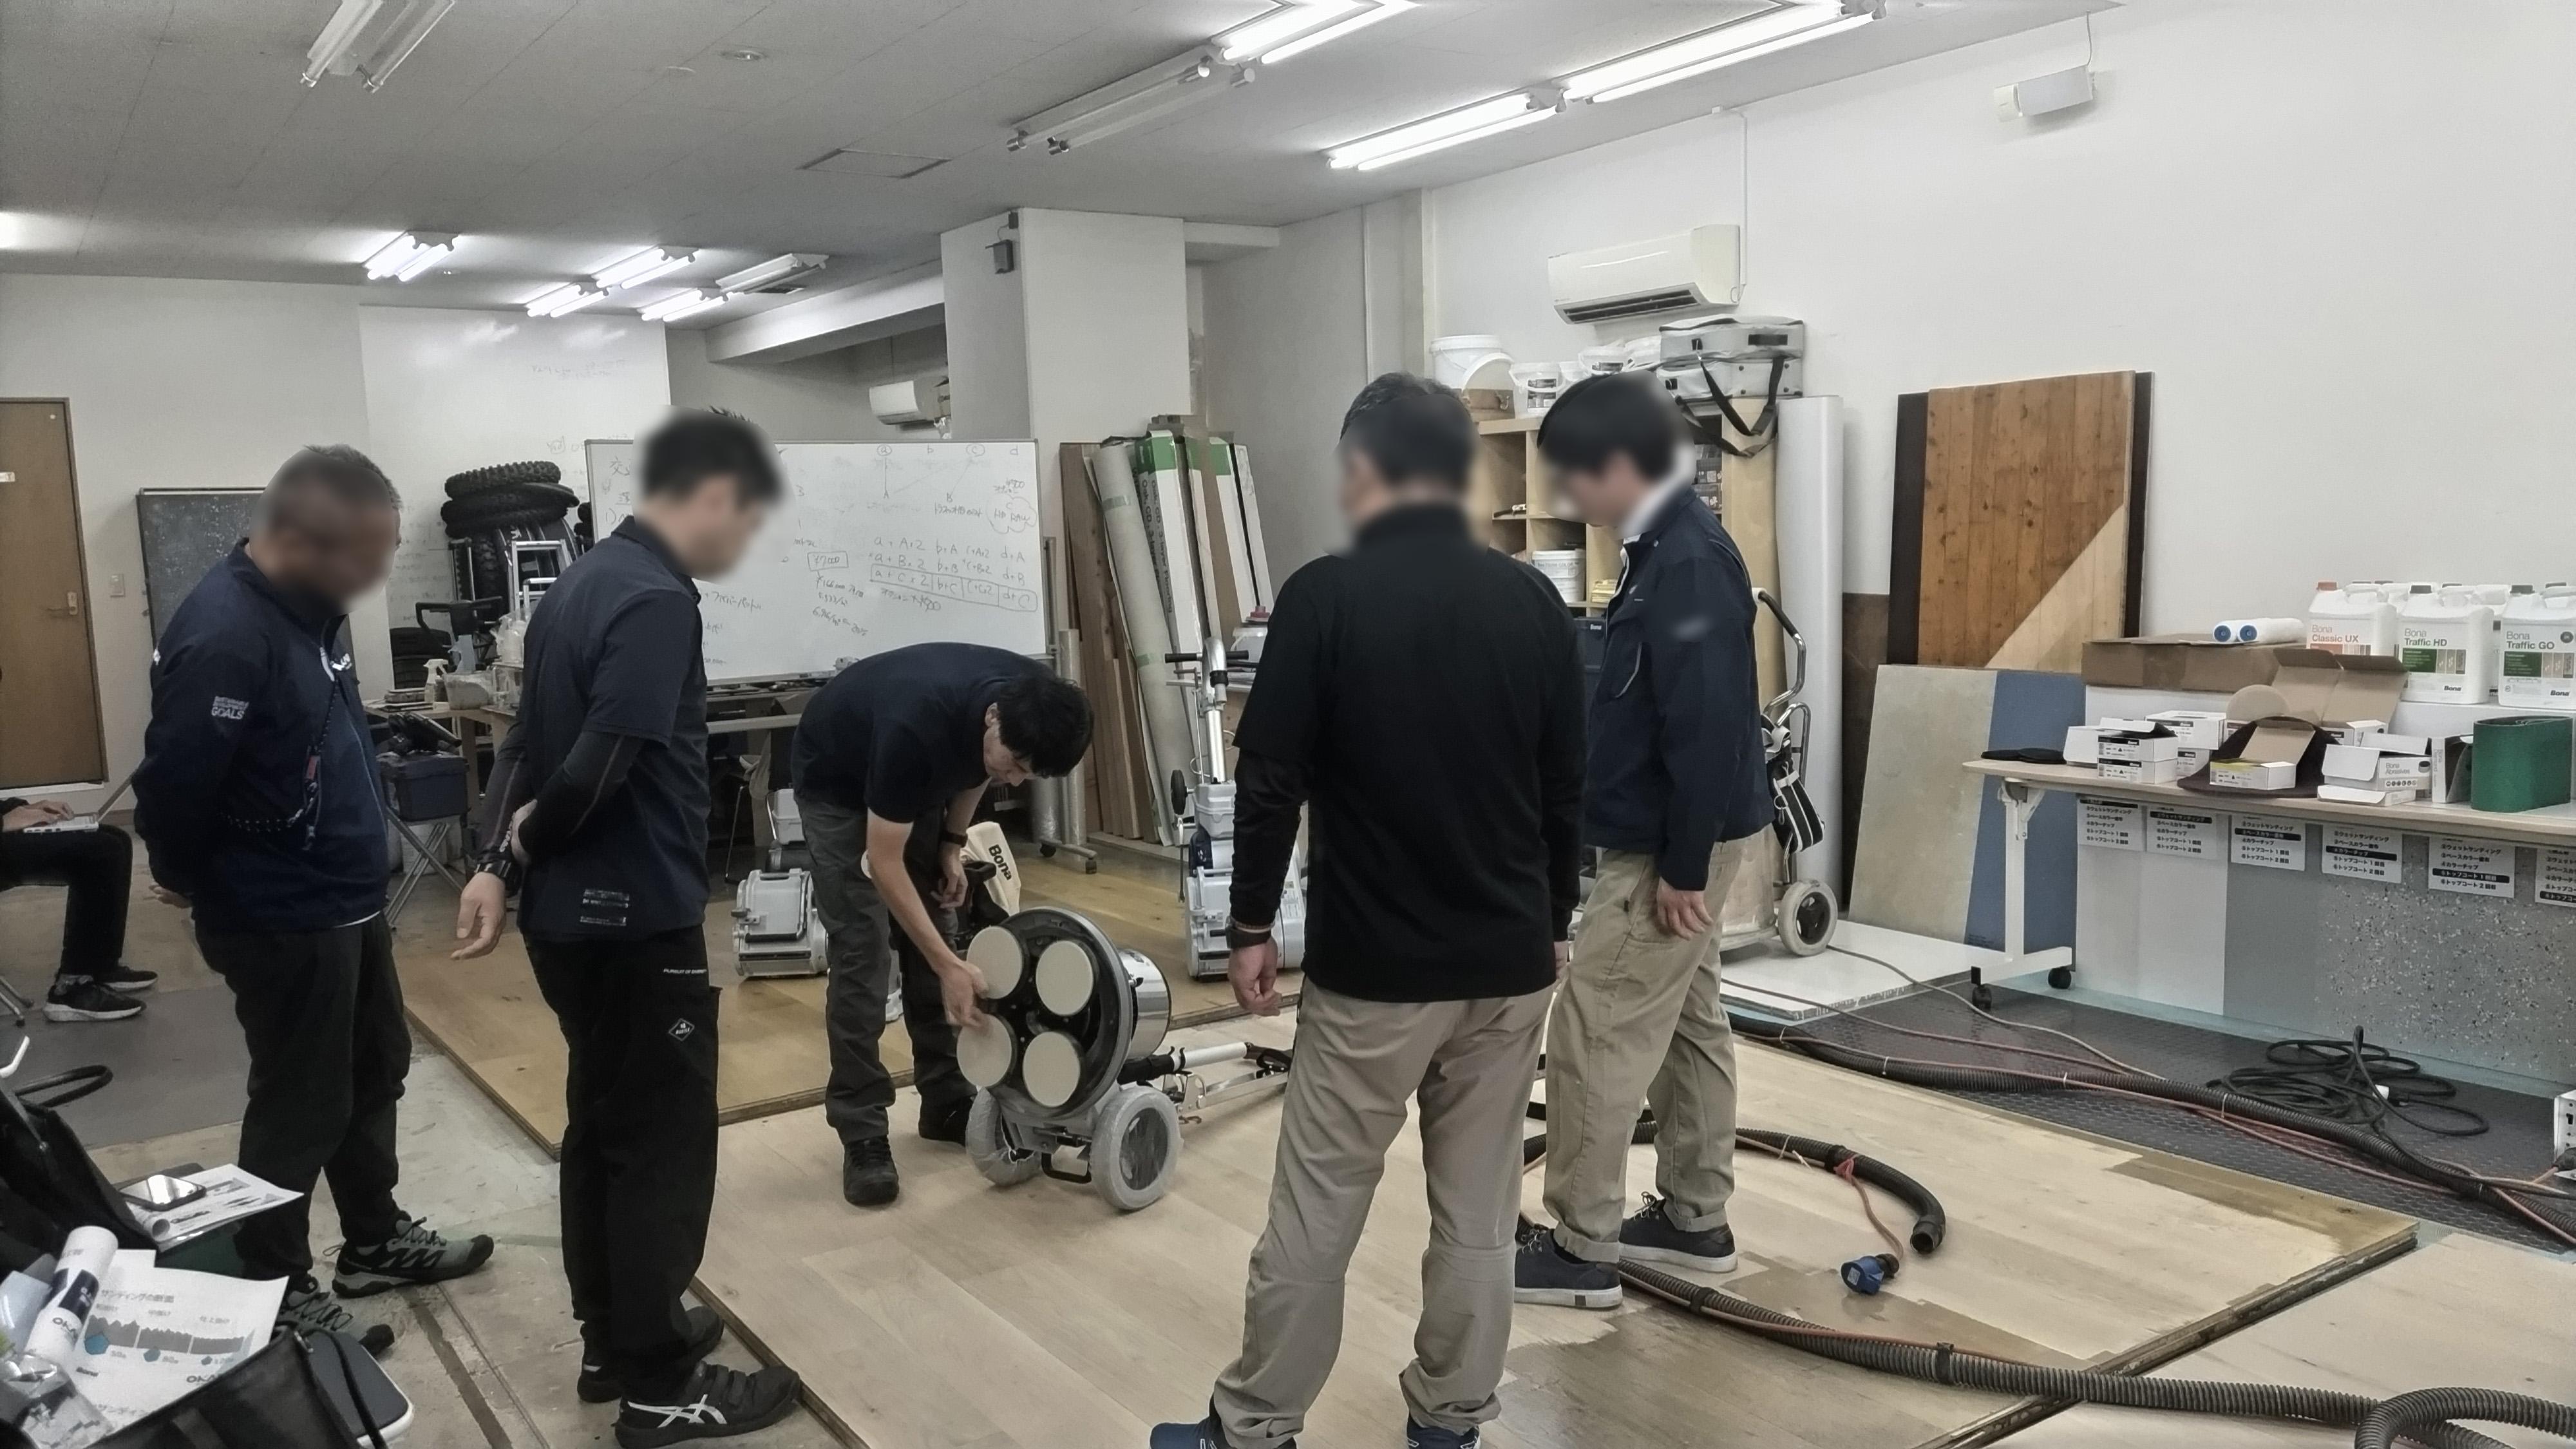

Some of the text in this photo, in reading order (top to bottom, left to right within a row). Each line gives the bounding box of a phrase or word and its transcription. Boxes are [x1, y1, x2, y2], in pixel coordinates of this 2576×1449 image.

[2312, 625, 2333, 634] Bona
[2404, 628, 2427, 638] Bona
[2311, 634, 2360, 643] Classic UX
[2506, 631, 2530, 640] Bona
[2404, 638, 2448, 647] Traffic HD
[2506, 641, 2555, 650] Traffic GO
[211, 706, 245, 720] GOALS
[988, 844, 1012, 881] Bona
